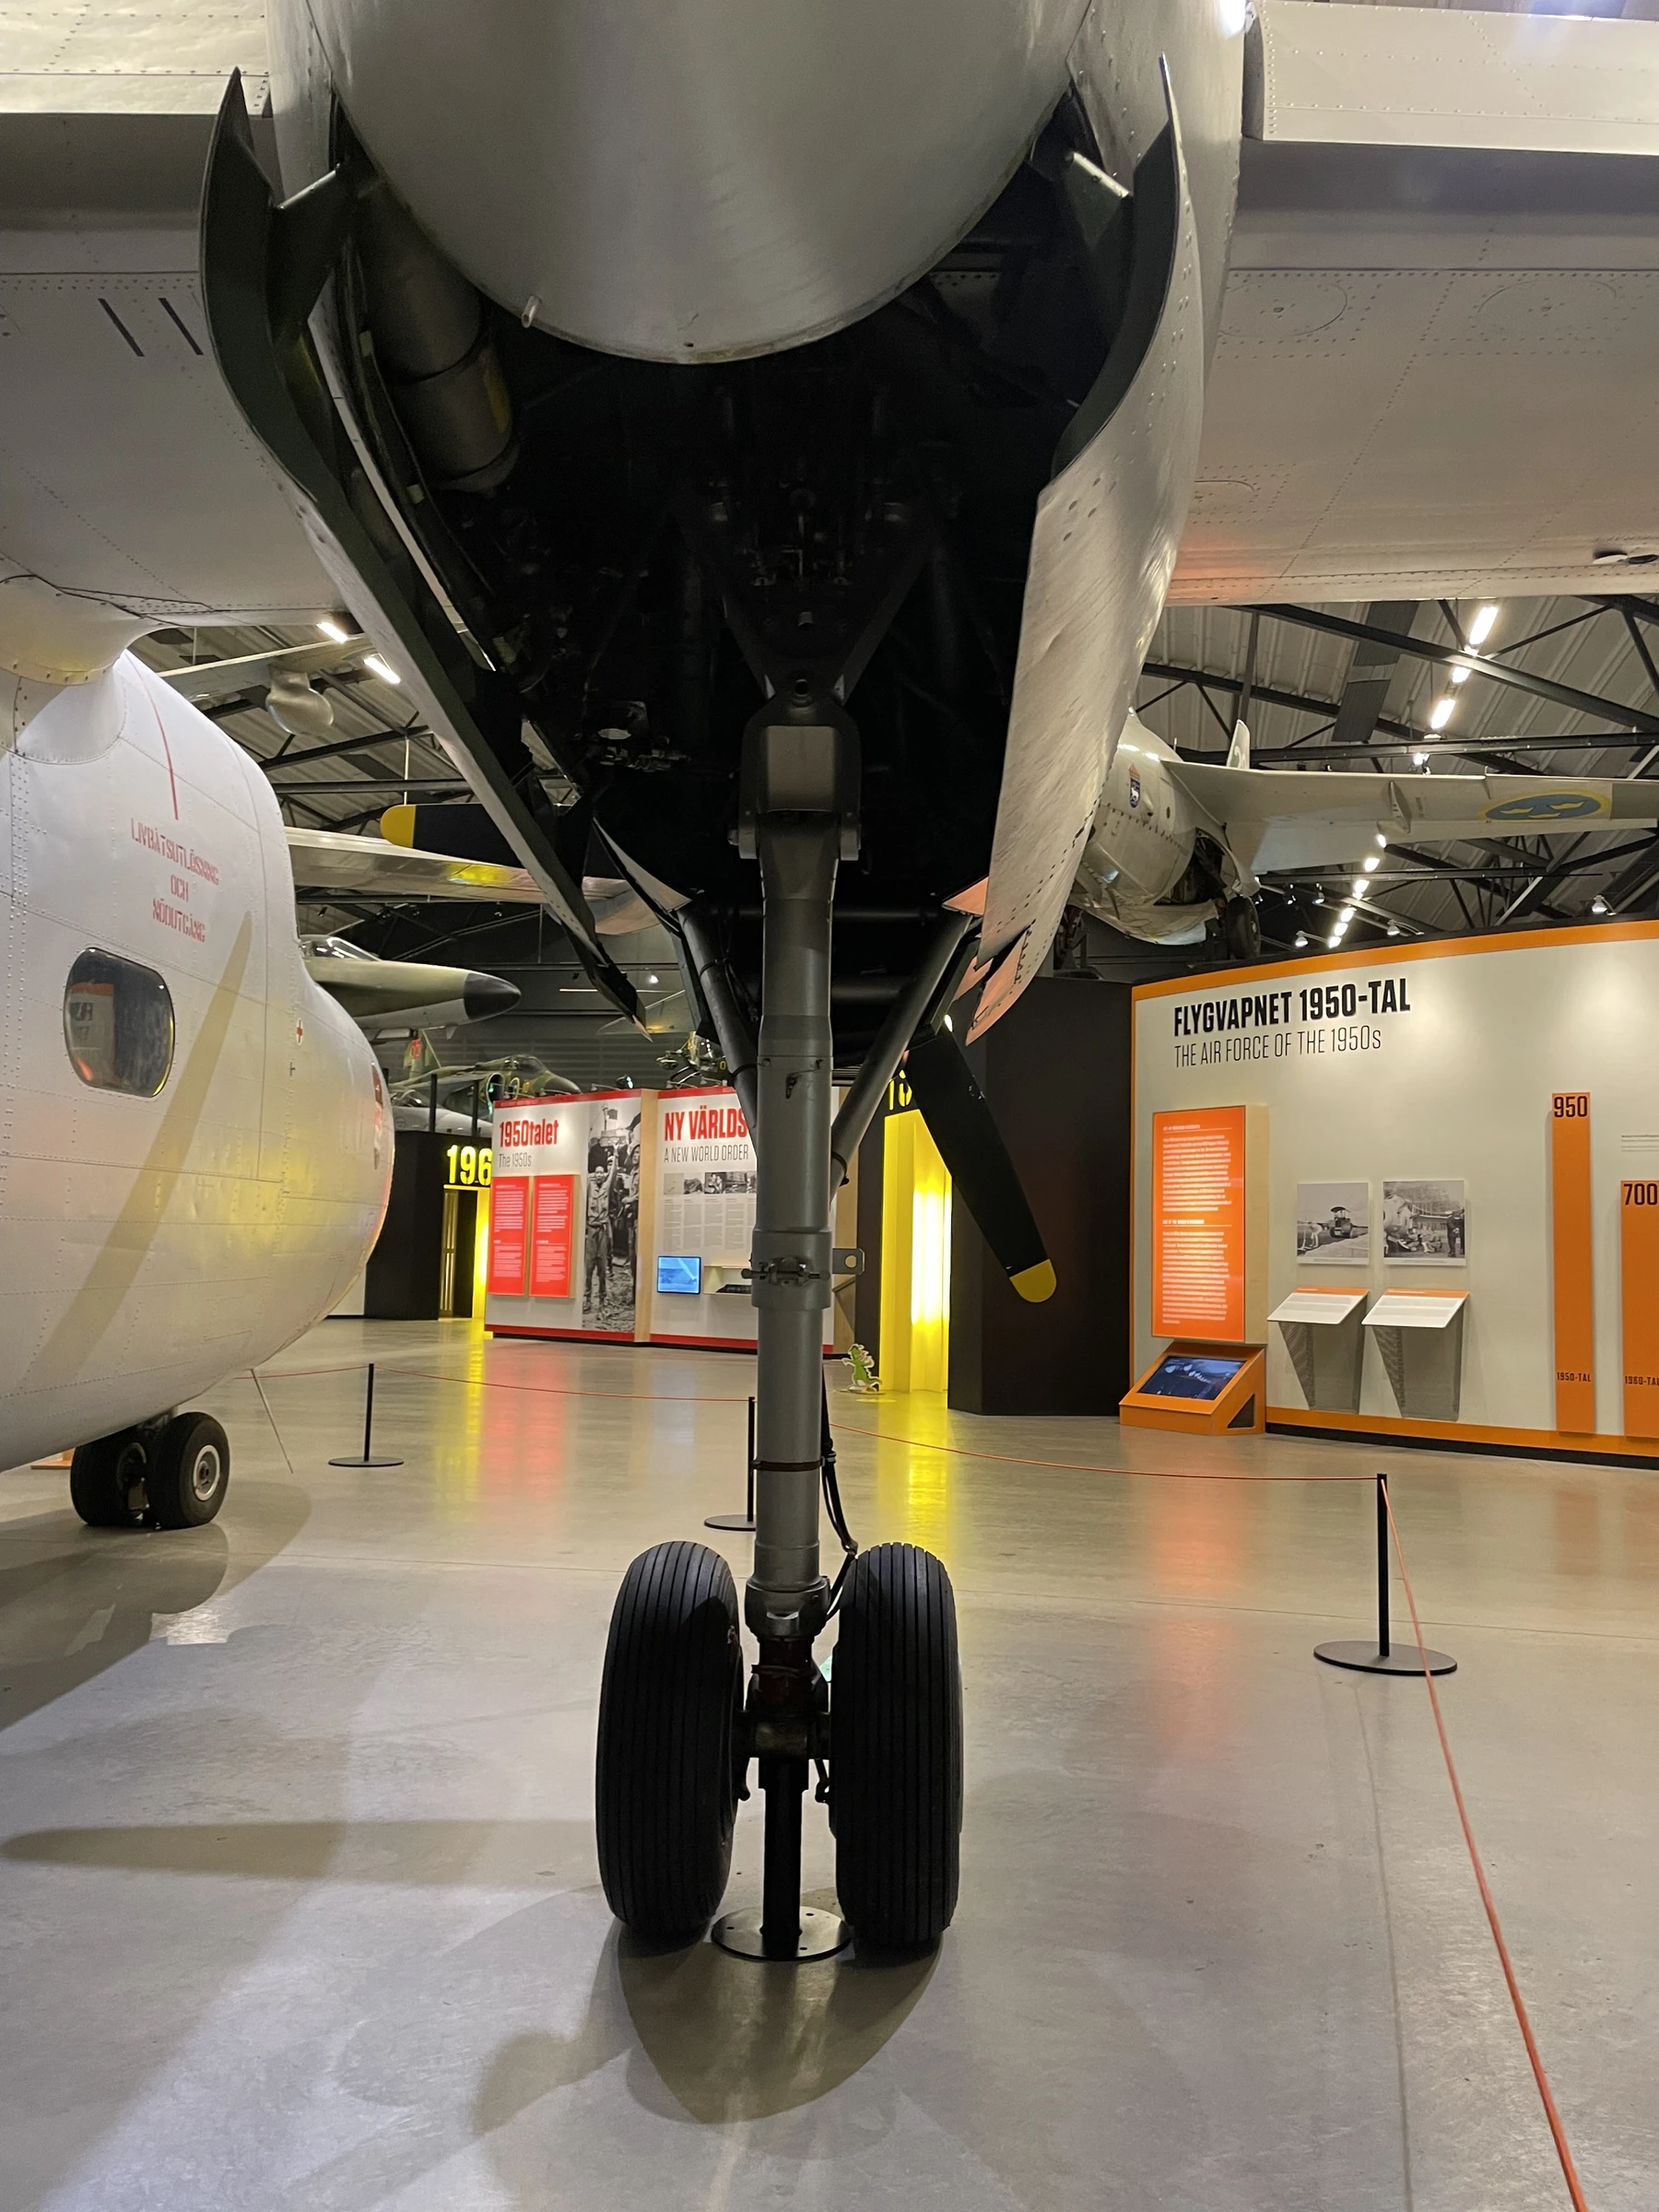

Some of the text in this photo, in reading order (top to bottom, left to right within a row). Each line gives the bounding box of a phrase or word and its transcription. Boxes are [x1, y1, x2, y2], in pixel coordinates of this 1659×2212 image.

[171, 874, 189, 902] OCH
[1173, 978, 1411, 1037] FLYGVAPNET 1950-TAL
[1174, 1025, 1382, 1068] THE AIR FORCE OF THE 1950s
[1554, 1096, 1588, 1118] 950
[500, 1118, 559, 1147] 1950talet
[665, 1112, 685, 1141] NY
[499, 1152, 532, 1168] The 1950s
[665, 1144, 749, 1162] A NEW WORLD ORDER
[1623, 1182, 1658, 1206] 700
[1557, 1371, 1591, 1382] 1950-TAL
